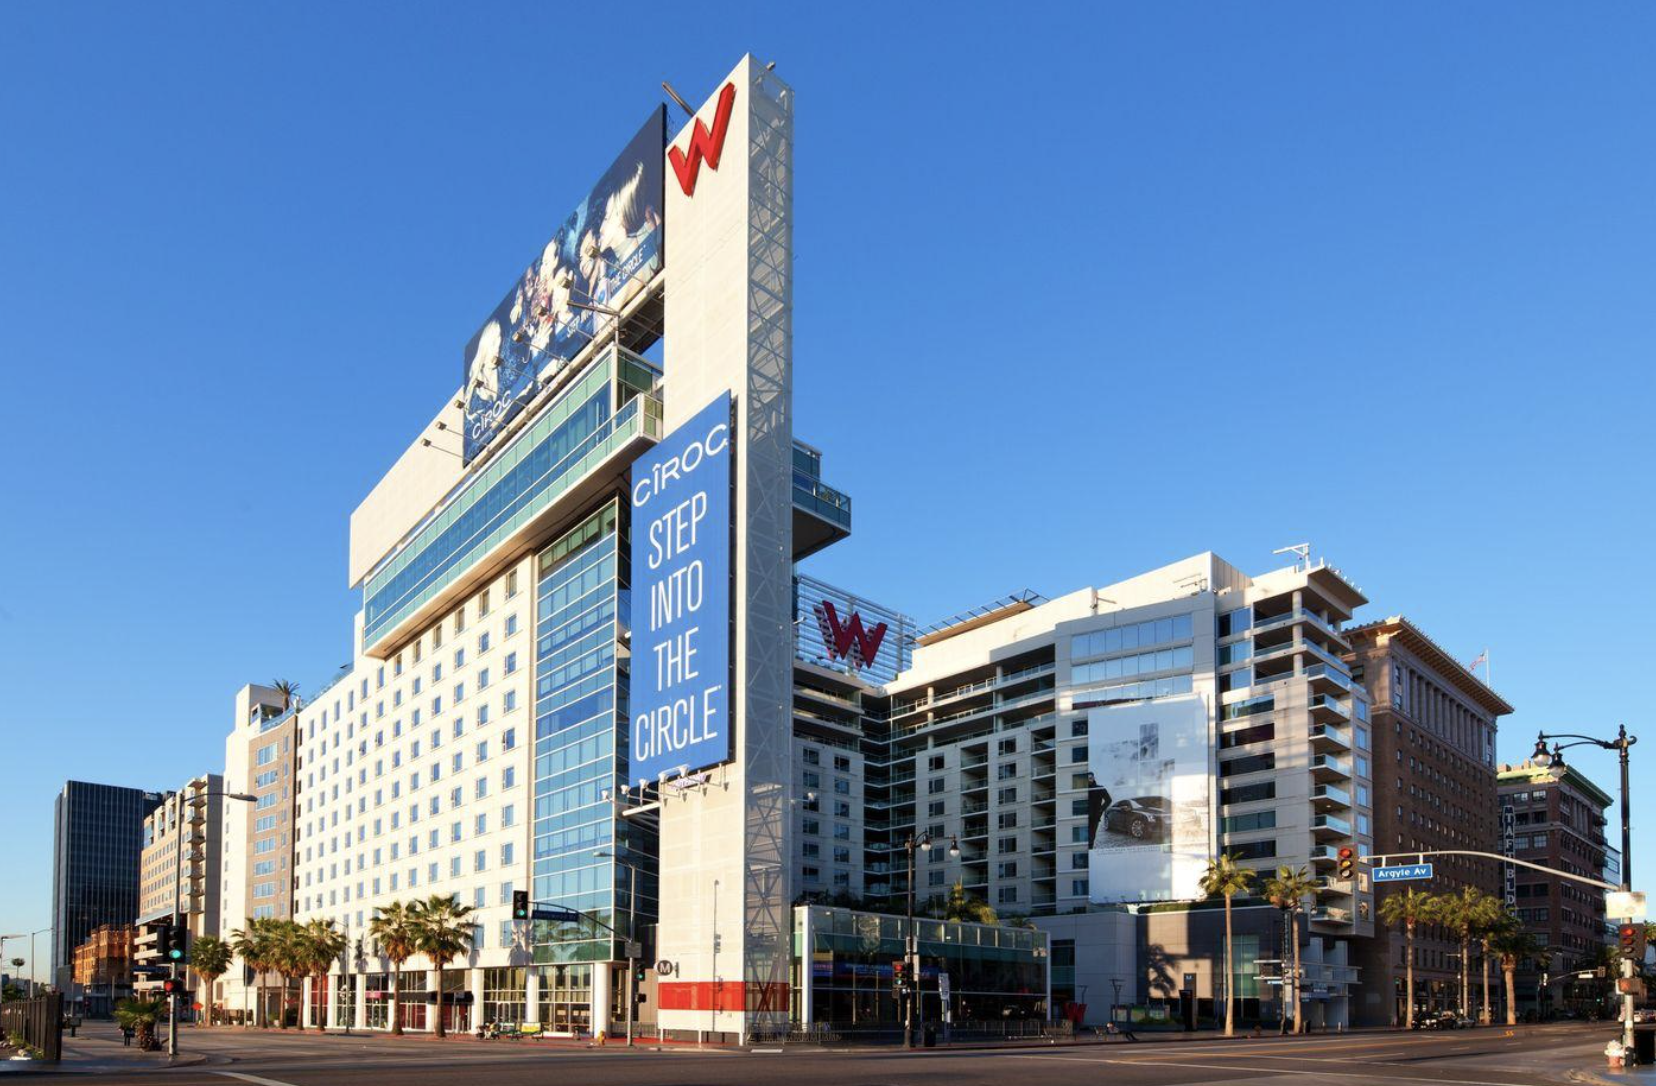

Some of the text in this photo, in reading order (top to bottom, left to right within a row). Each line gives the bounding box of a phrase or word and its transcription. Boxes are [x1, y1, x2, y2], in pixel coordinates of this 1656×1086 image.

[668, 82, 736, 197] W
[633, 424, 728, 507] CÎROC
[648, 491, 707, 570] STEP
[651, 560, 703, 632] INTO
[653, 627, 699, 692] THE
[815, 600, 888, 671] W
[635, 686, 719, 762] CIRCLE
[1378, 867, 1427, 879] Argyle Av
